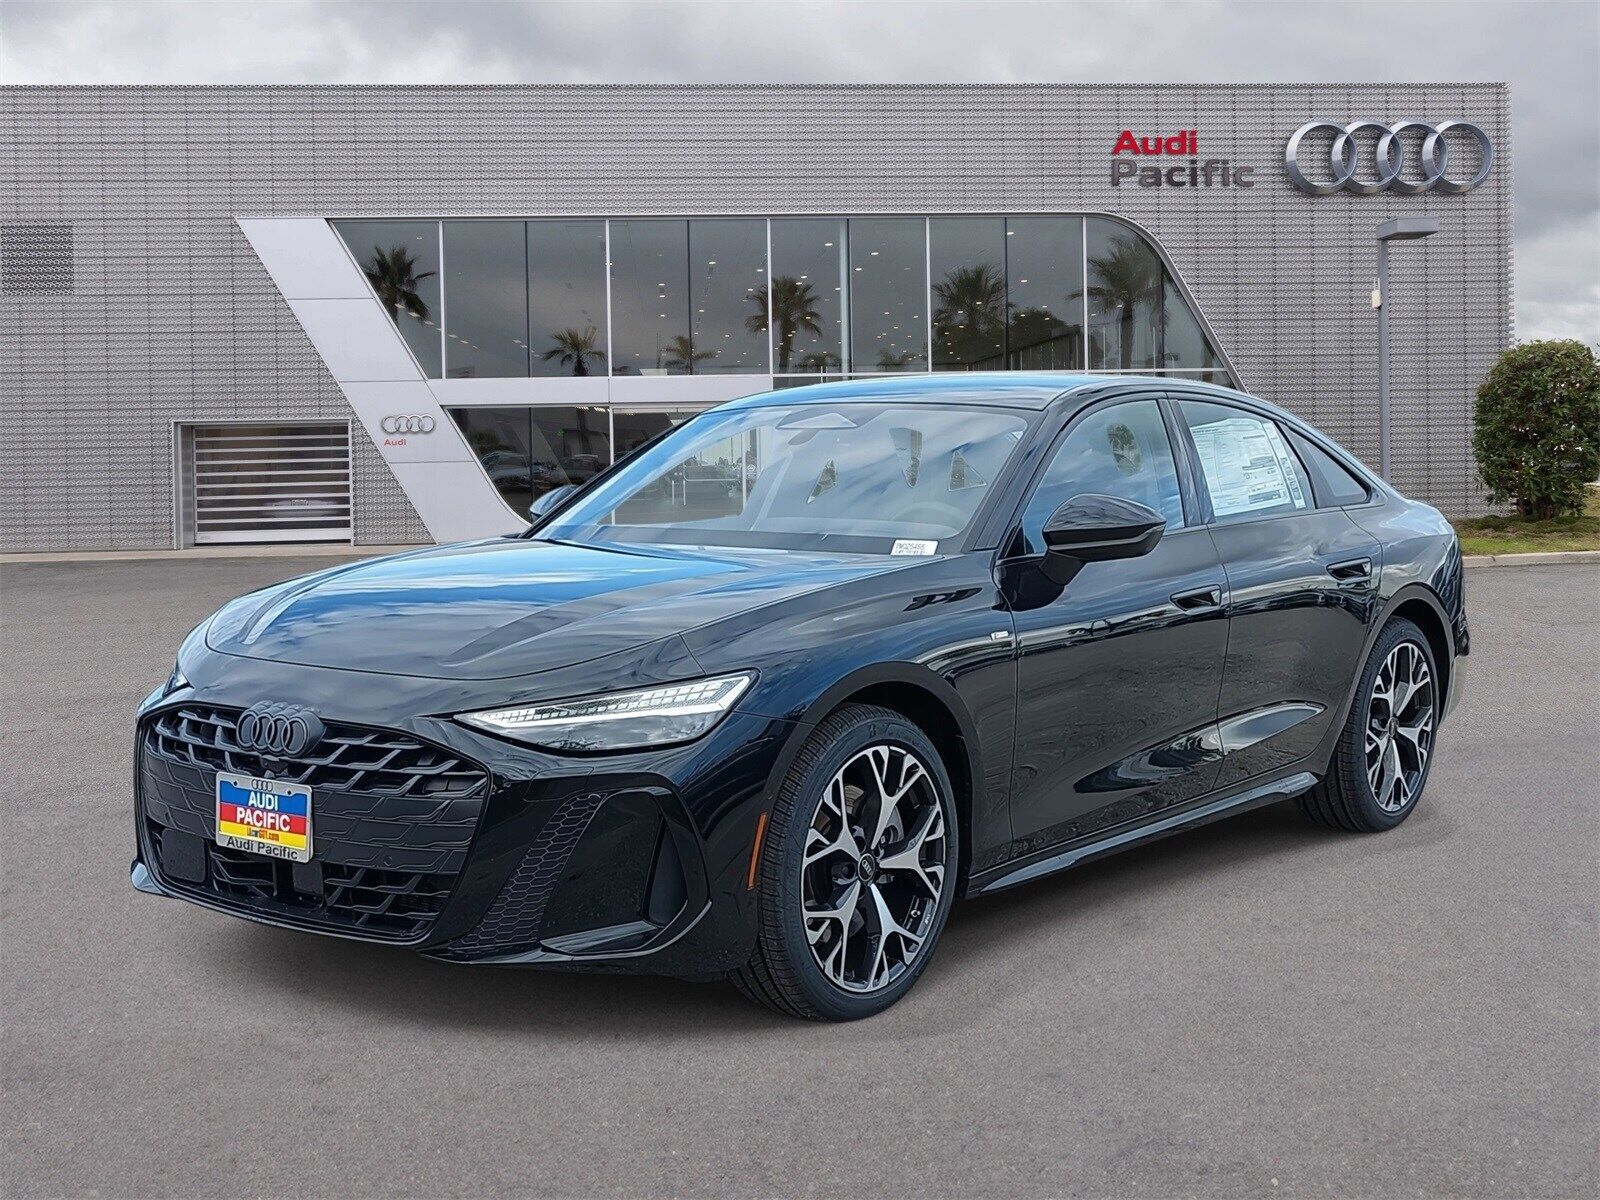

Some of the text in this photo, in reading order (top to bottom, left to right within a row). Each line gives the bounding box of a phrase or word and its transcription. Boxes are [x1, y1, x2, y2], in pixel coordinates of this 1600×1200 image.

[1111, 129, 1199, 156] Audi
[1111, 159, 1255, 187] Pacific
[384, 438, 407, 446] Audi
[248, 791, 279, 811] AUDI
[236, 807, 291, 832] PACIFIC
[226, 836, 298, 860] Audi Pacific
